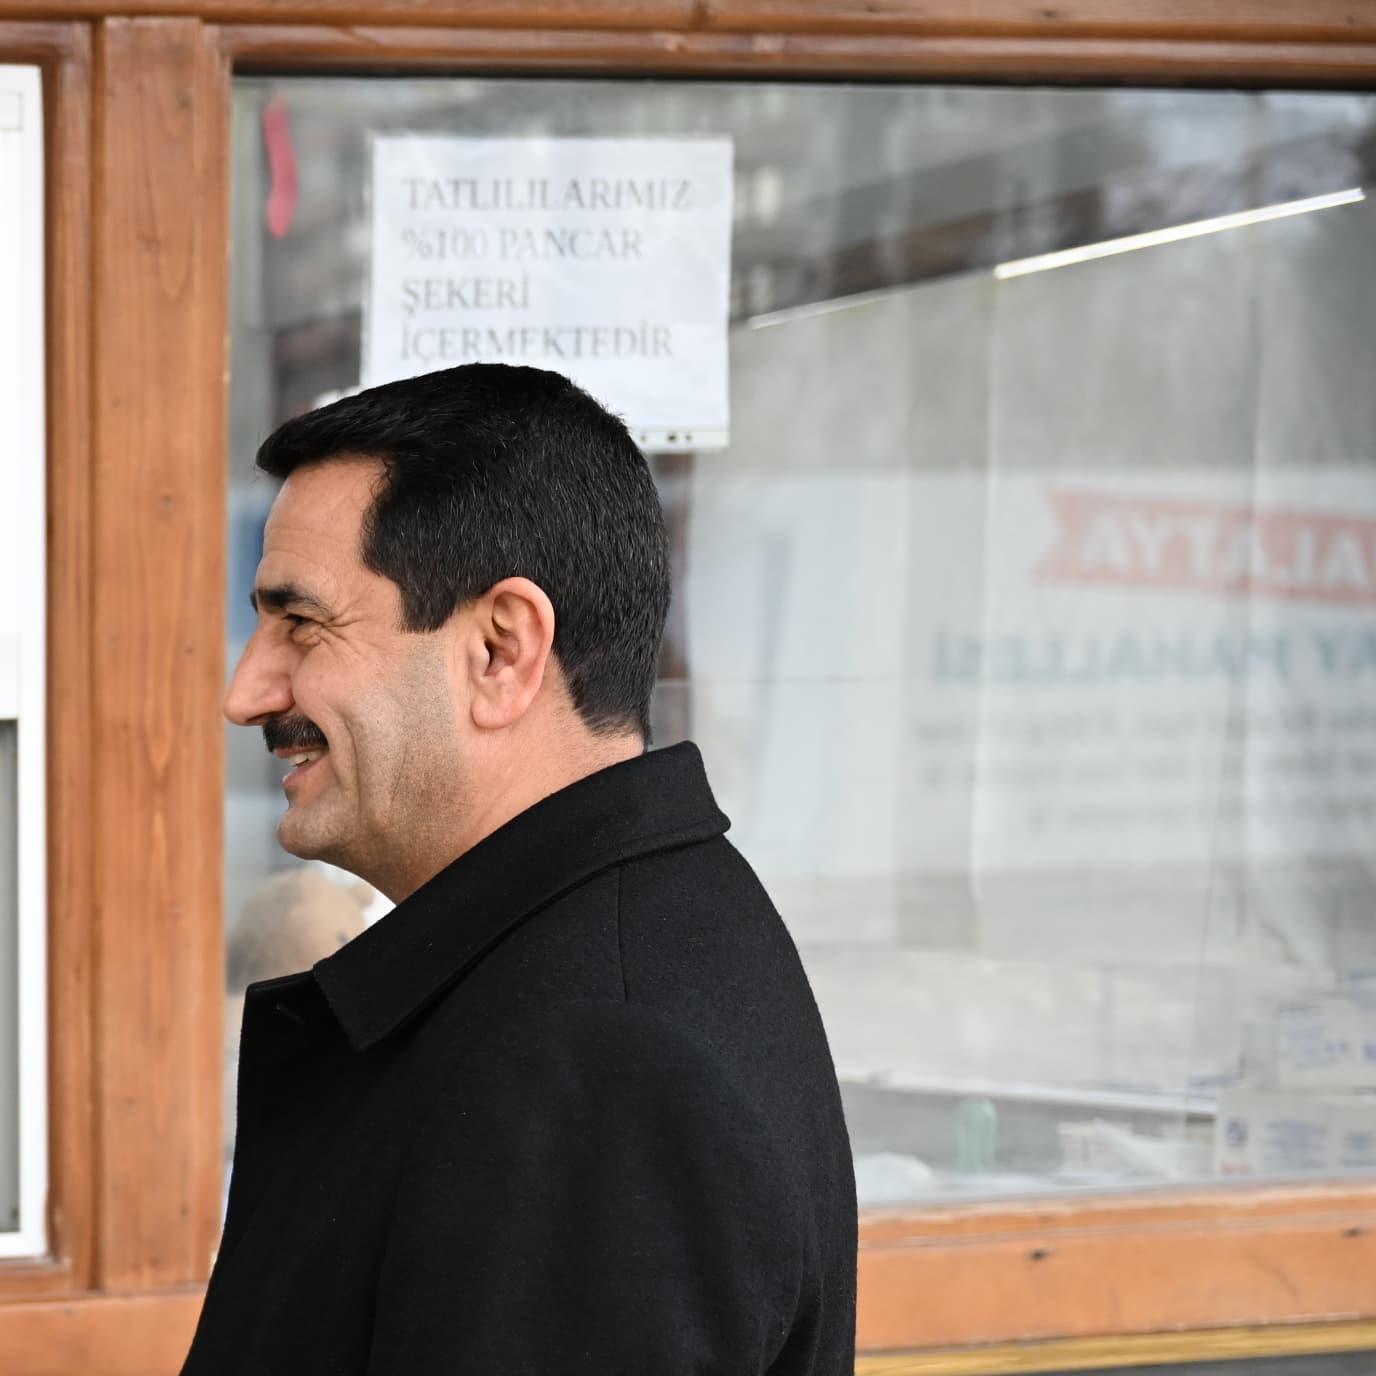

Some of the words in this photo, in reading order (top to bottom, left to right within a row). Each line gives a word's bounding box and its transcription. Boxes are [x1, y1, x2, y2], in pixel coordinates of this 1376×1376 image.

[401, 227, 489, 261] %100
[499, 227, 644, 261] PANCAR
[401, 270, 531, 318] ŞEKERİ
[401, 316, 674, 364] İÇERMEKTEDİR
